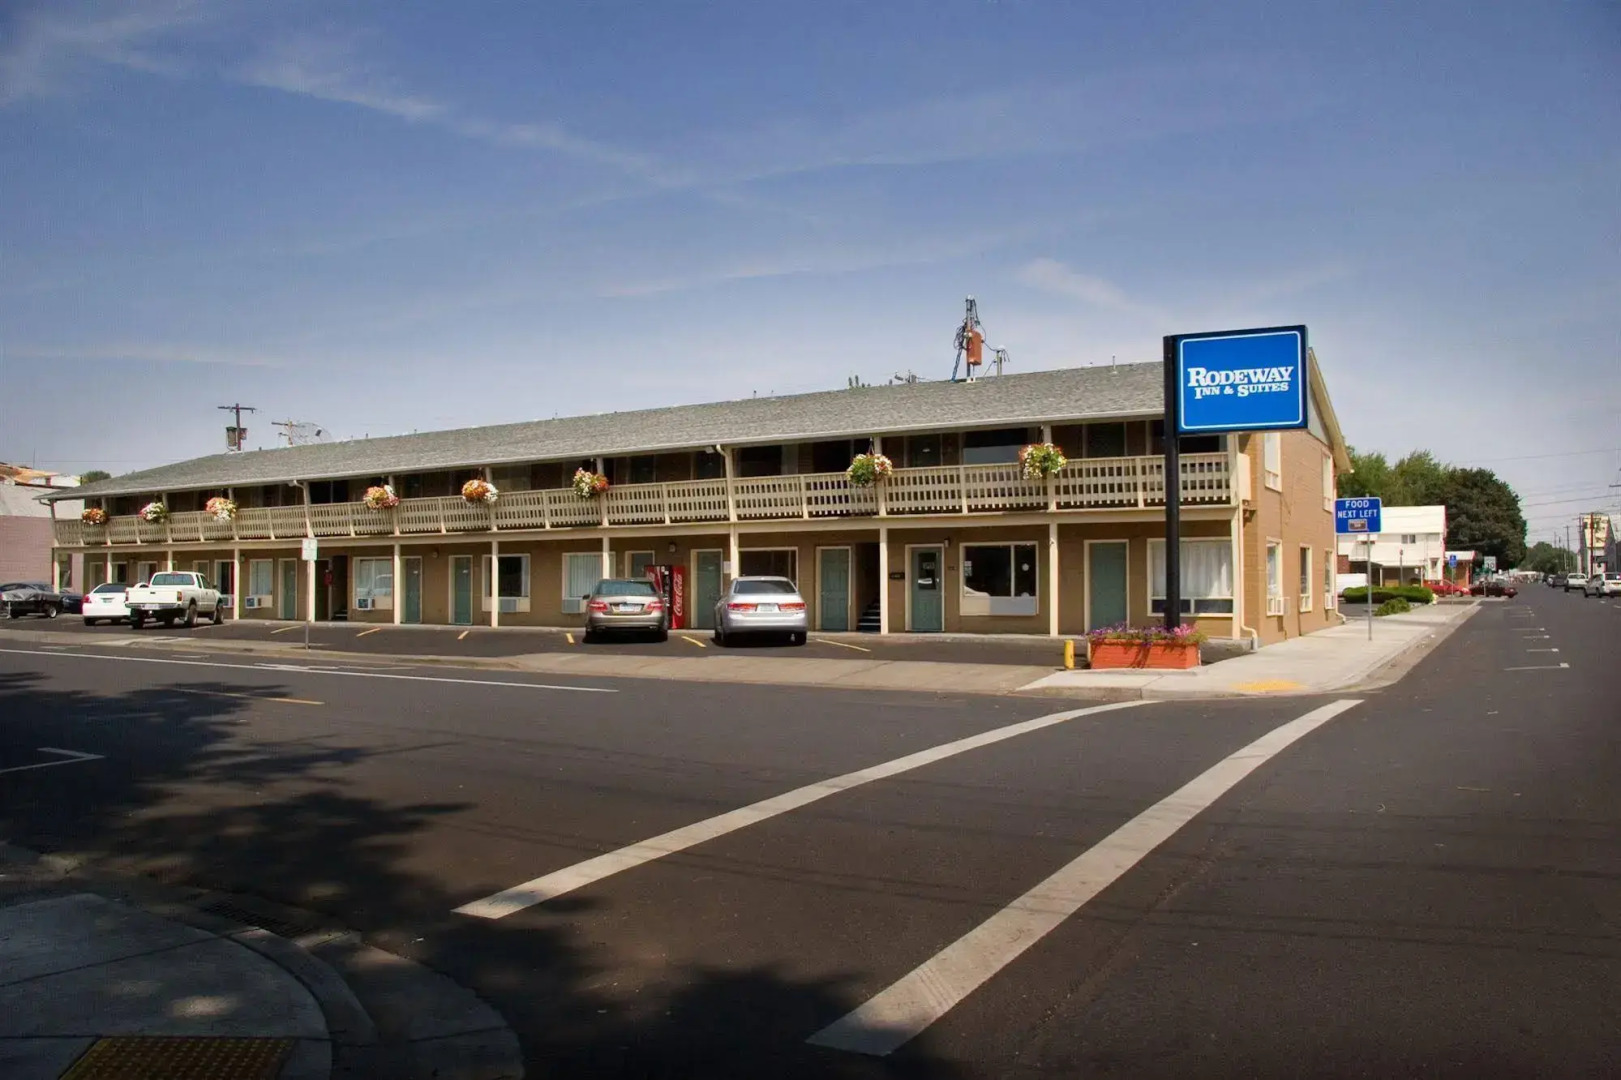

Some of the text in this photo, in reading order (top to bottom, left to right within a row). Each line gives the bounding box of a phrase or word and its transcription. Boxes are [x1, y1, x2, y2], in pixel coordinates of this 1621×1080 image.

[1188, 367, 1294, 387] RODEWAY
[1195, 382, 1289, 399] INN & SUITES
[1346, 500, 1369, 508] FOOD
[1338, 509, 1377, 518] NEXT LEFT
